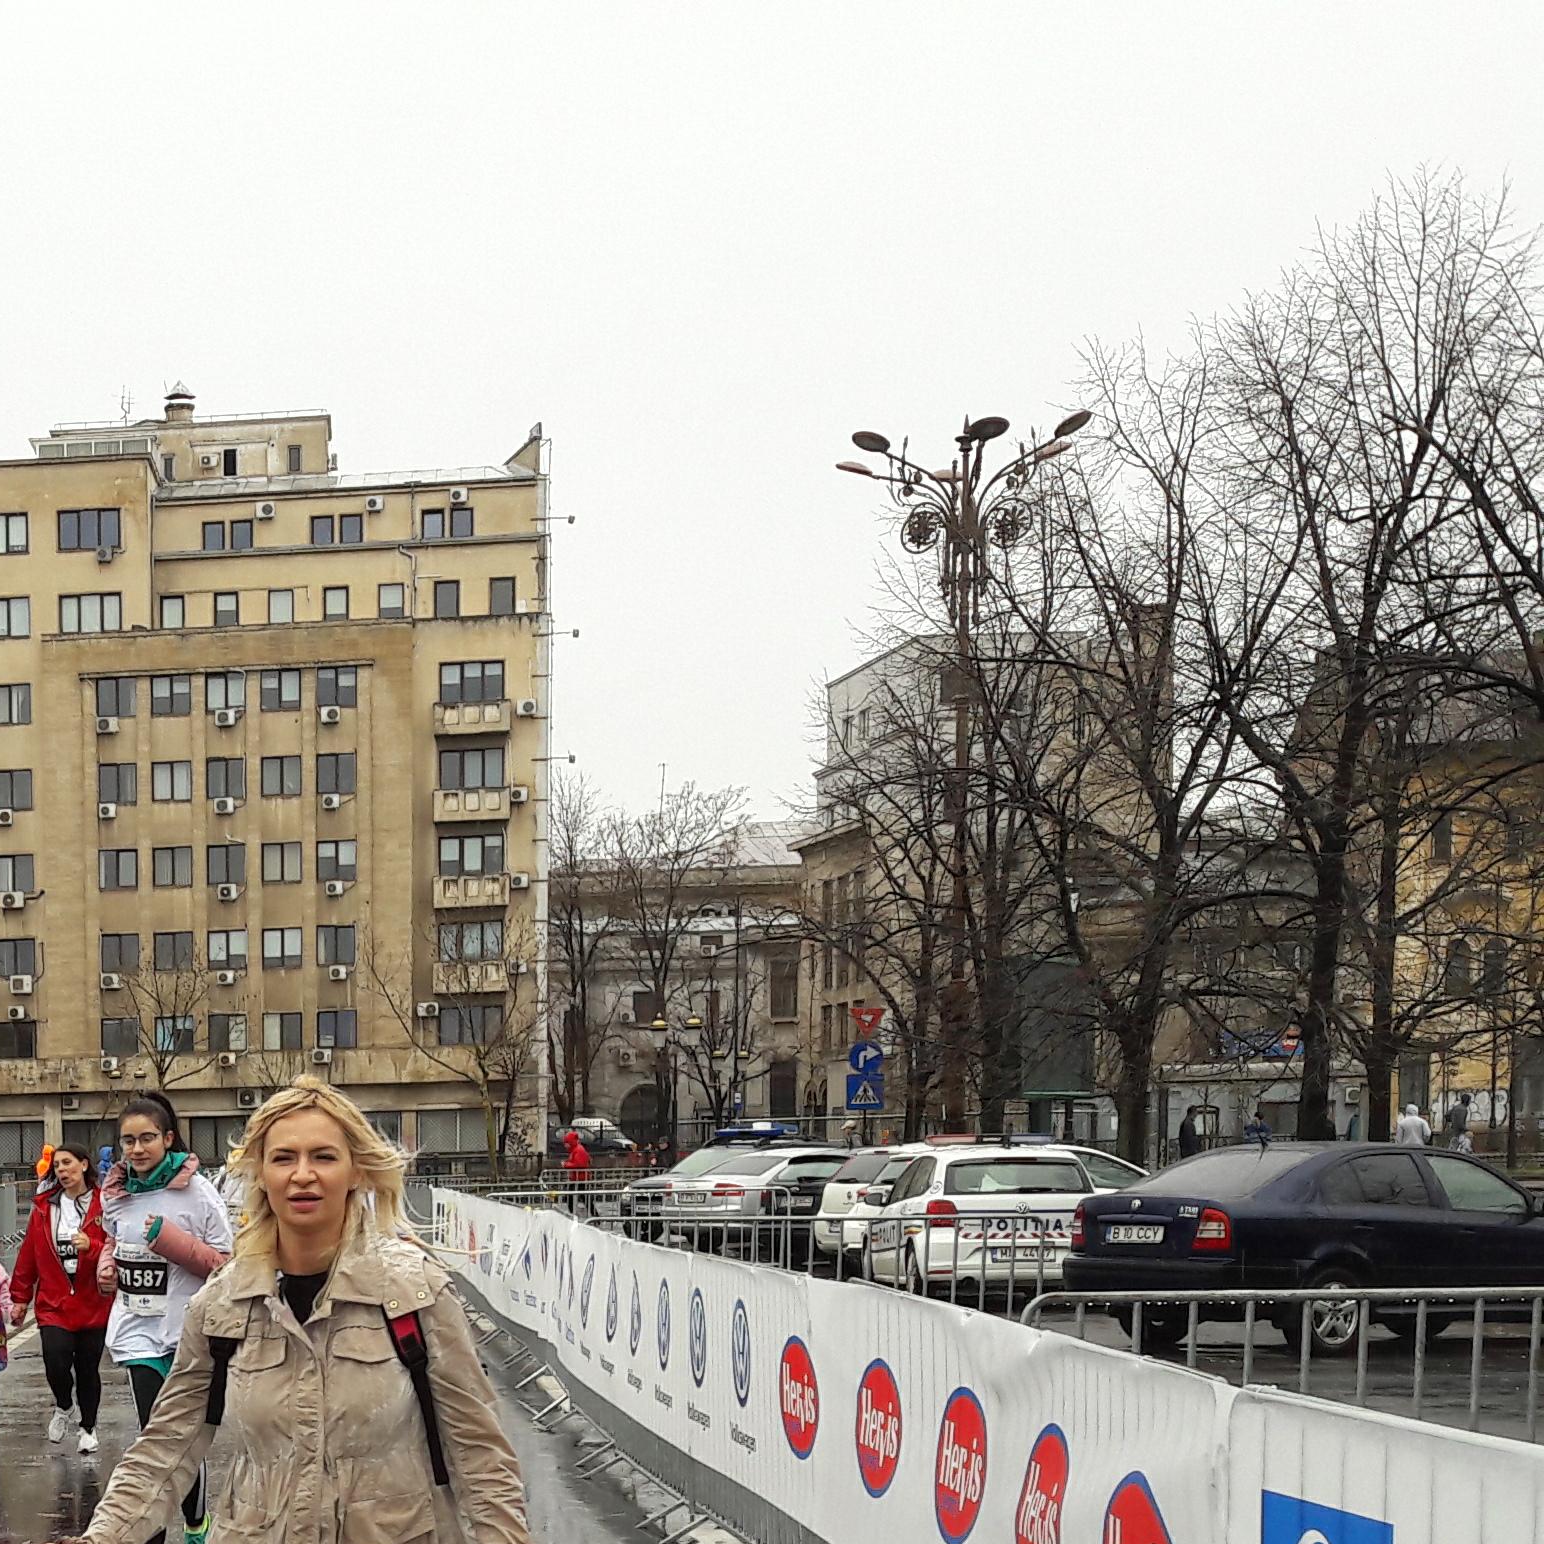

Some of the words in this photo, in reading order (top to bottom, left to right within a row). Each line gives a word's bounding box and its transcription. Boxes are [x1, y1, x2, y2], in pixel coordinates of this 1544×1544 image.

[1137, 1227, 1160, 1239] CCY
[782, 1361, 816, 1433] Hervis
[859, 1387, 899, 1468] Hervis
[939, 1419, 983, 1512] Hervis
